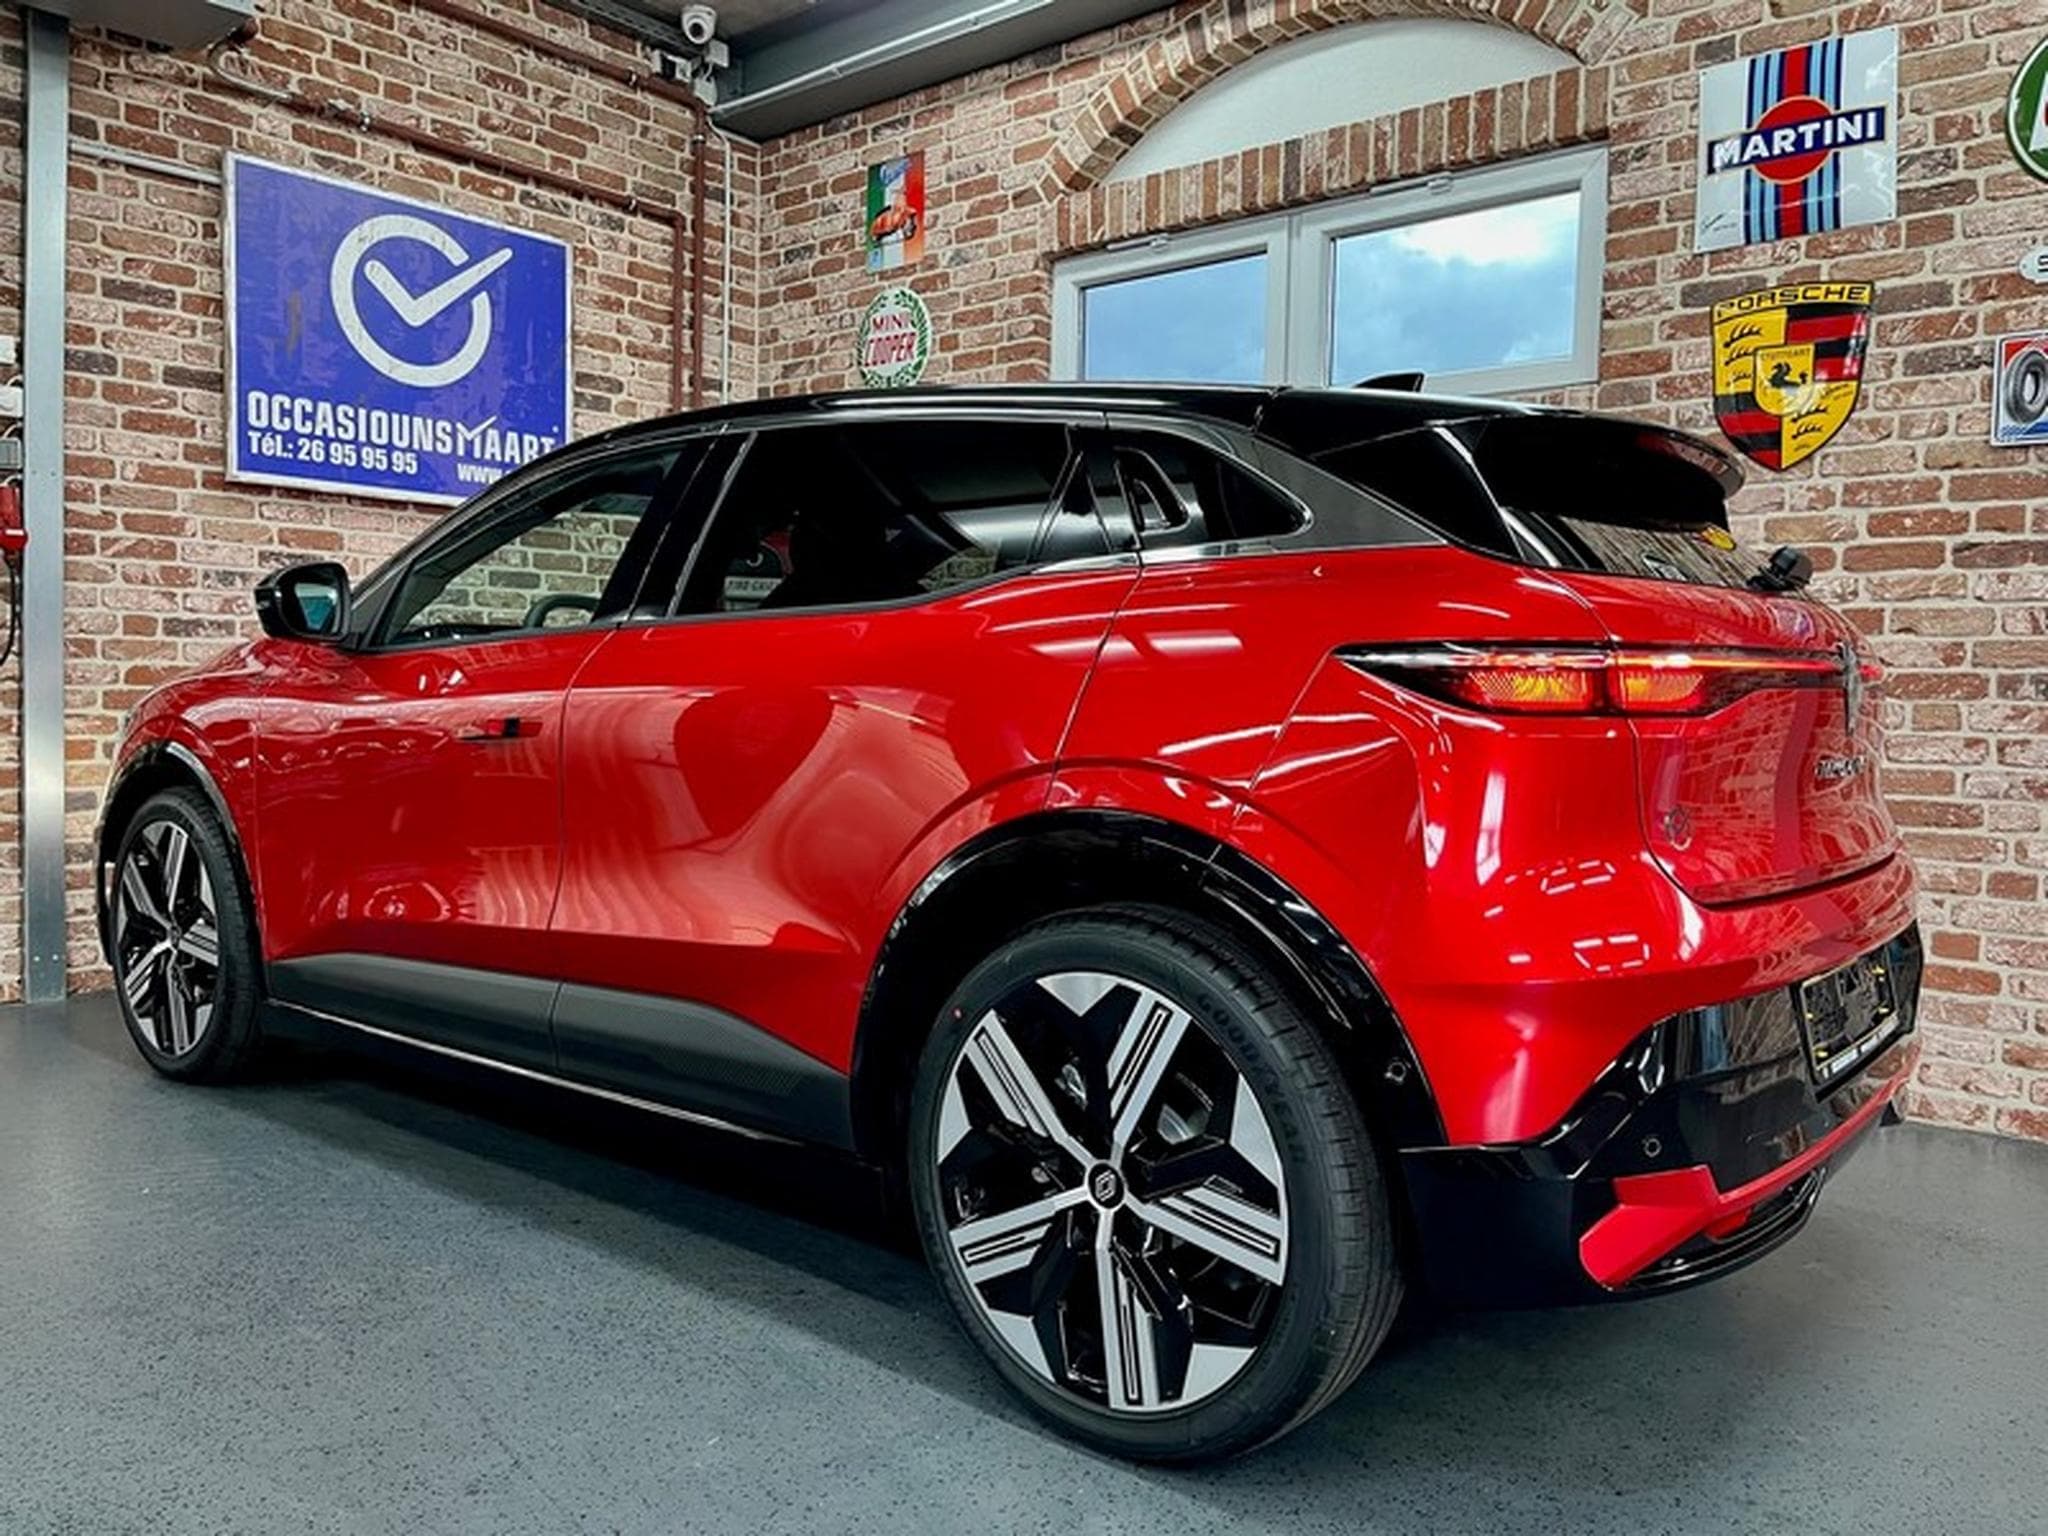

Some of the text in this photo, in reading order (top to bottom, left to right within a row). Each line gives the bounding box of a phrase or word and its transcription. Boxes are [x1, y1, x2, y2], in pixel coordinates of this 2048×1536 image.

[1713, 111, 1877, 170] MARTINI
[1717, 285, 1867, 318] PORSCHE
[871, 310, 912, 334] MINI
[864, 331, 918, 368] COOPER
[247, 431, 419, 476] Tél.: 26 95 95 95
